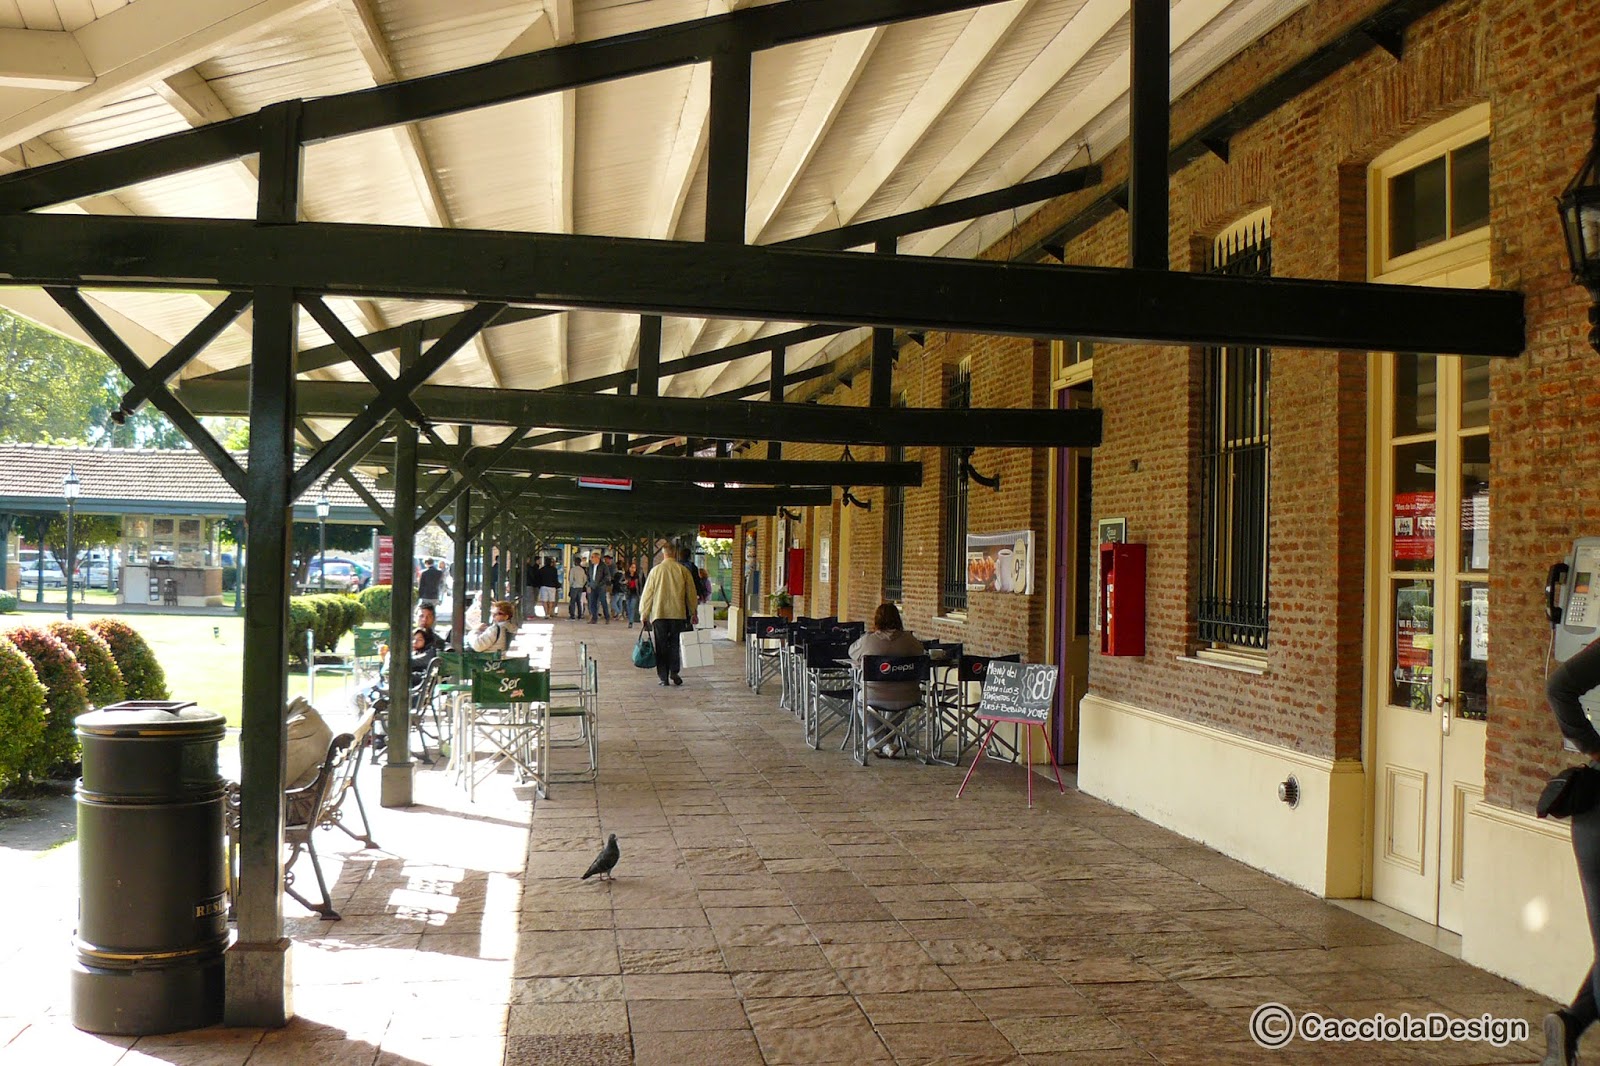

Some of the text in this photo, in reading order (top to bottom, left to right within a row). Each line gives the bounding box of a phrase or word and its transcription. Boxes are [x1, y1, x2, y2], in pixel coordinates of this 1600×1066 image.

[484, 660, 503, 672] Ser
[892, 663, 914, 673] pepsi
[1007, 666, 1018, 678] del
[499, 677, 521, 693] Ser
